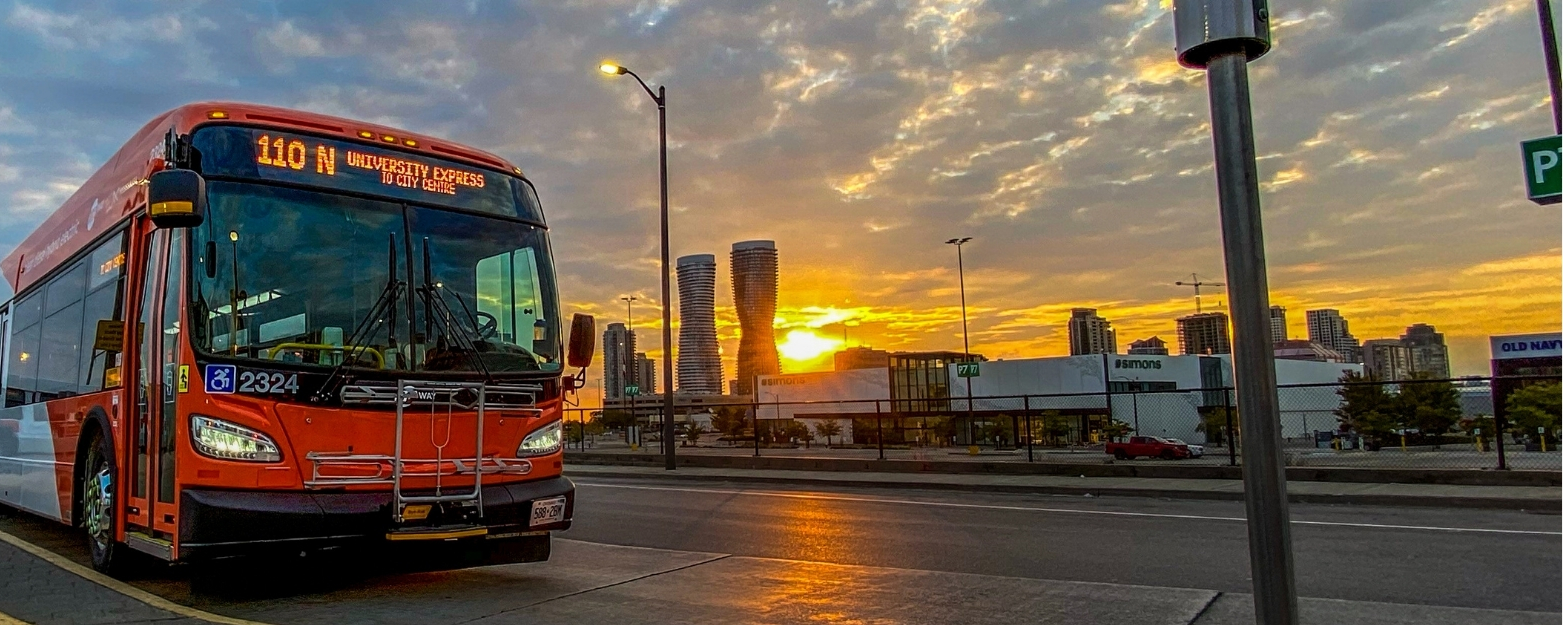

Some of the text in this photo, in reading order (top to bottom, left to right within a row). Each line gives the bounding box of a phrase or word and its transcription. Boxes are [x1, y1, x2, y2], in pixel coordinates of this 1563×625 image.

[258, 134, 485, 188] 110 N UNIVERSITY EXPRESS
[381, 170, 456, 195] TO CITY CENTRE
[1502, 341, 1527, 352] OLD
[958, 365, 968, 374] P7
[1122, 359, 1162, 369] simons
[239, 371, 299, 394] 2324
